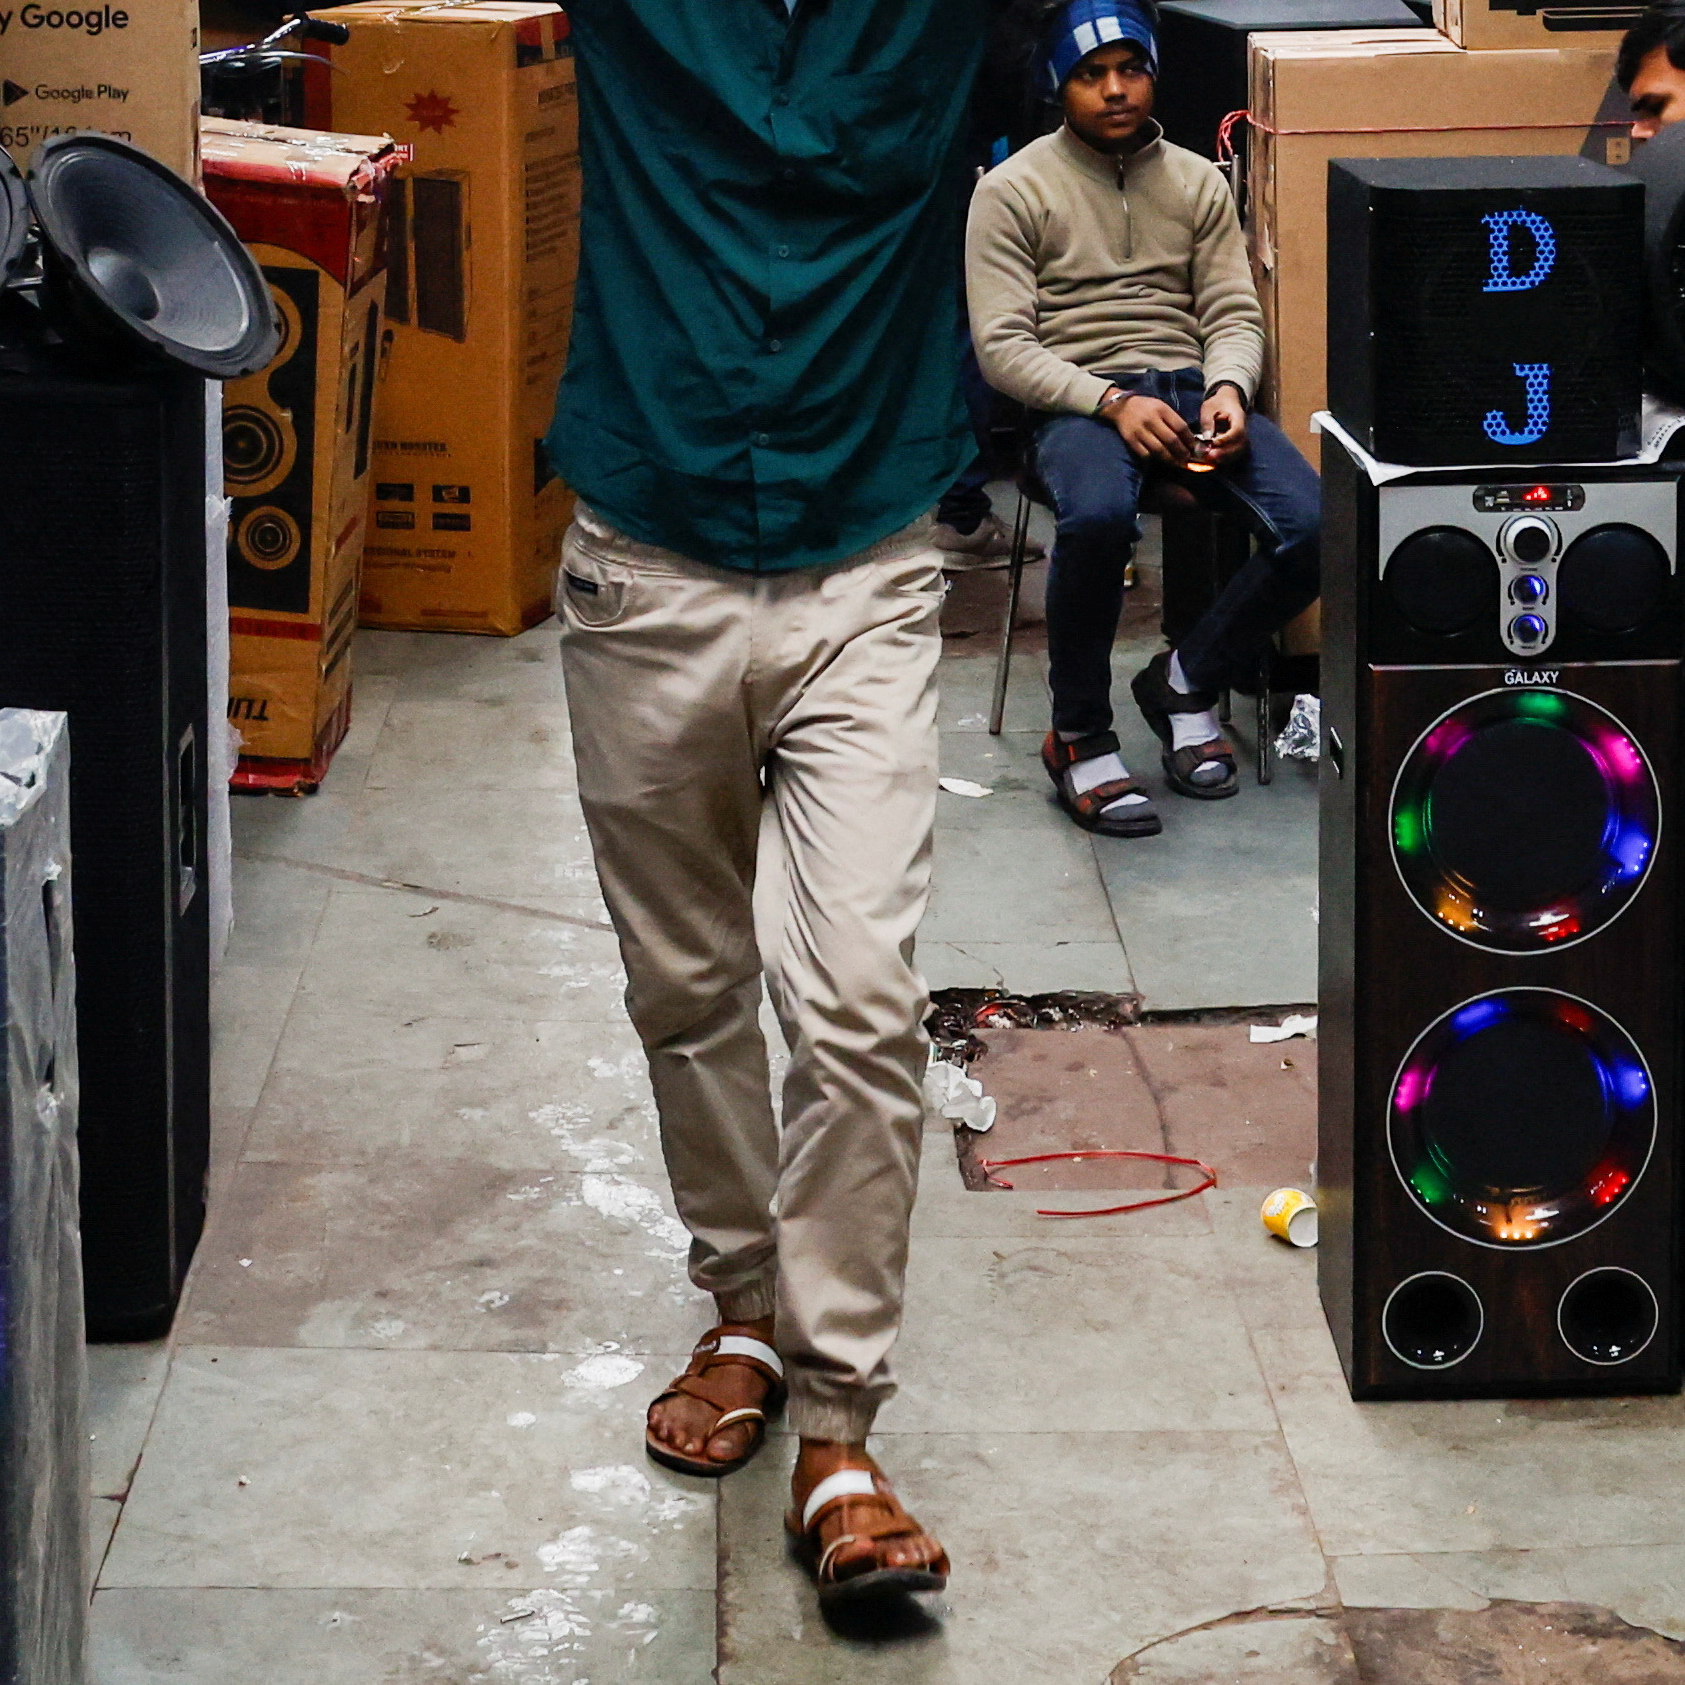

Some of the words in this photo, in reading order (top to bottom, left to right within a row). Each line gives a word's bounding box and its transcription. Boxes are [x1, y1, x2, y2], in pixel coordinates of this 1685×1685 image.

[20, 4, 129, 36] Google
[35, 84, 94, 104] Google
[96, 83, 130, 102] Play
[1504, 670, 1560, 685] GALAXY
